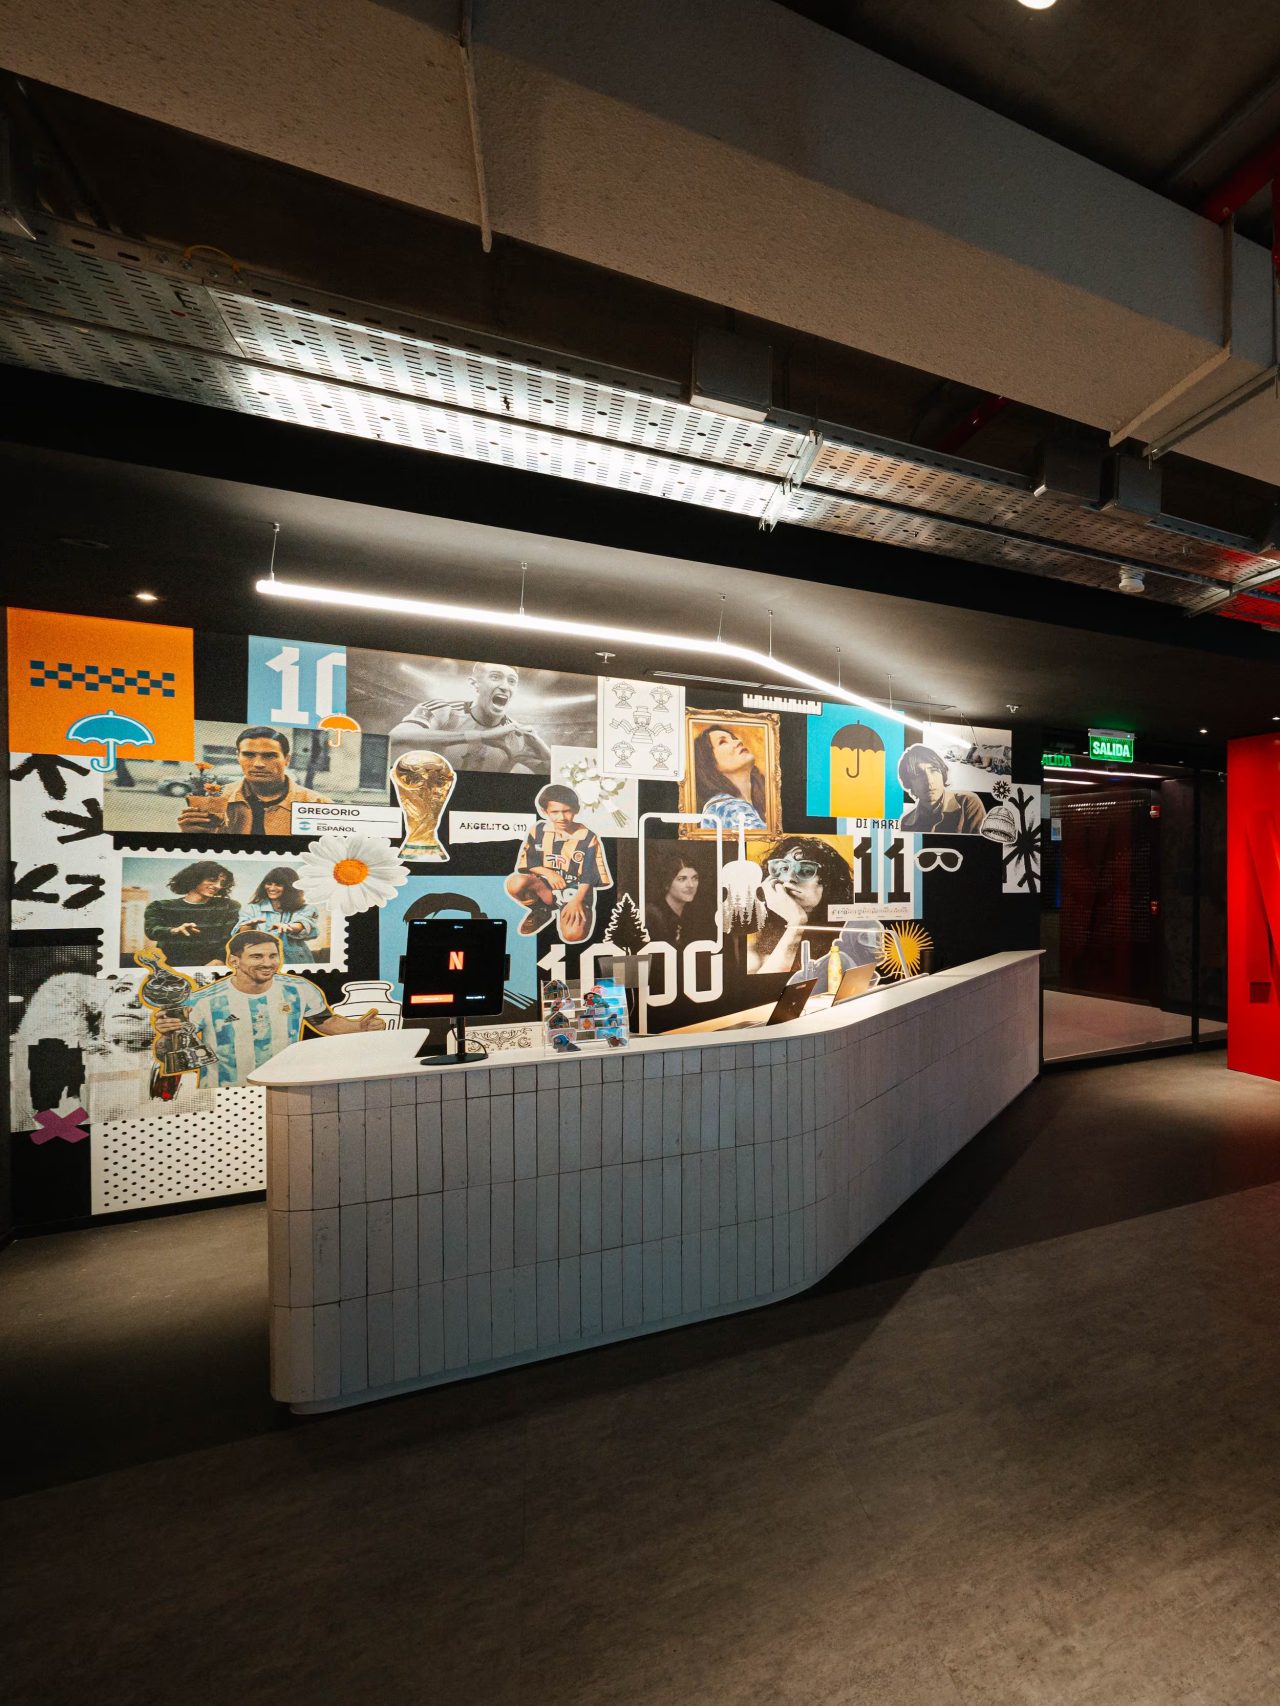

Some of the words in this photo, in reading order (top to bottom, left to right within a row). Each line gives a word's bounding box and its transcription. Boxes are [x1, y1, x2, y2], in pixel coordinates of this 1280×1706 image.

[1092, 741, 1131, 757] SALIDA
[298, 807, 360, 816] GREGORIO
[316, 825, 356, 833] ESPAÑOL
[856, 818, 868, 828] DI
[853, 836, 911, 904] 11
[449, 951, 464, 970] N
